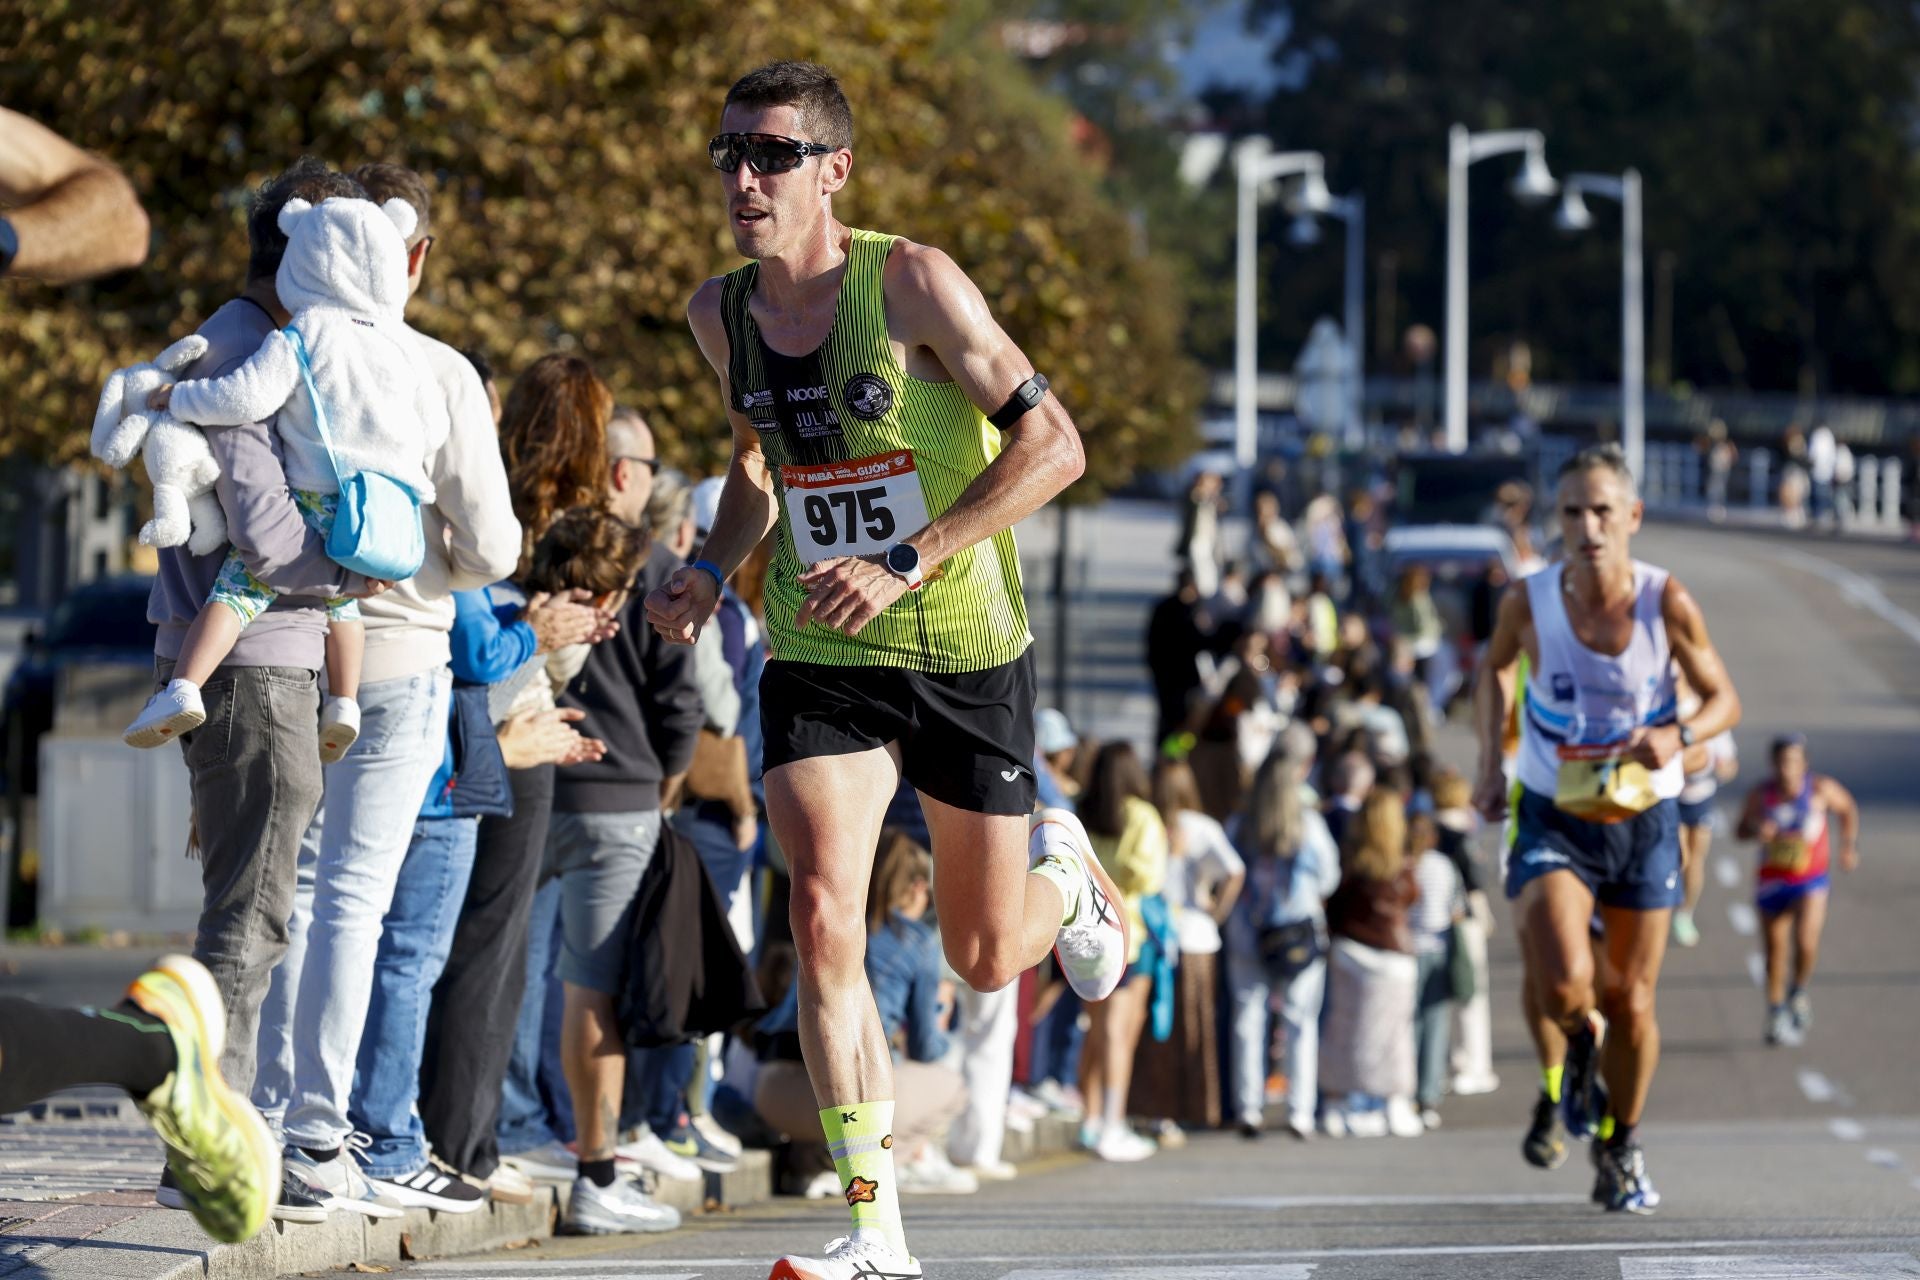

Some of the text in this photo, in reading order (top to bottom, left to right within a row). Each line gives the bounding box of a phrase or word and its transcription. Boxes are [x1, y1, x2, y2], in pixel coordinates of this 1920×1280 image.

[857, 463, 890, 477] GIJÓN
[807, 472, 836, 483] MBA
[803, 485, 896, 547] 975
